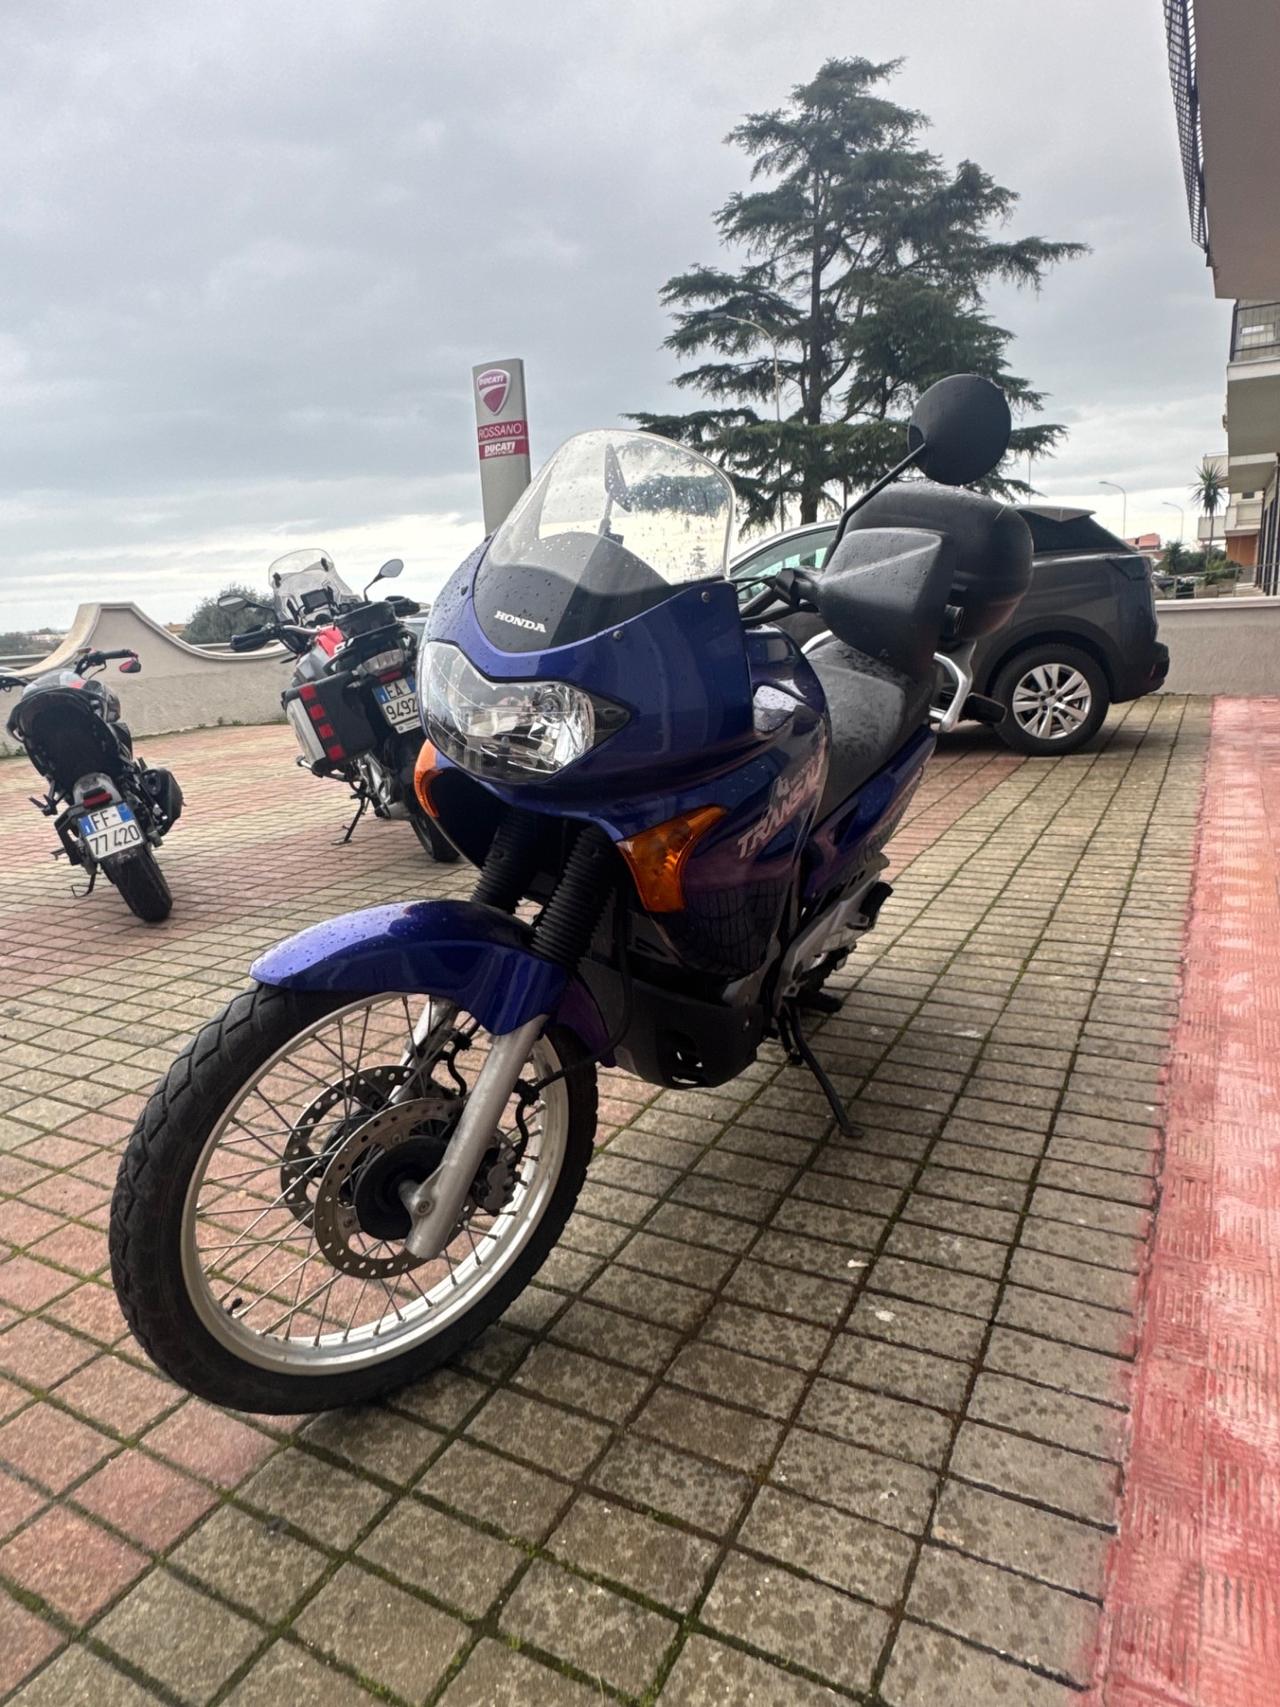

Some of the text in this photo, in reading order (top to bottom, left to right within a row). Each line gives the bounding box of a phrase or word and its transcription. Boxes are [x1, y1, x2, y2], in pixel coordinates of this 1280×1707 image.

[479, 375, 504, 386] DUCATI
[479, 422, 522, 440] ROSSANO
[484, 441, 516, 454] DUCATI
[494, 610, 546, 633] HONDA
[385, 683, 404, 699] EA
[386, 698, 418, 720] 9492
[91, 809, 110, 830] FF
